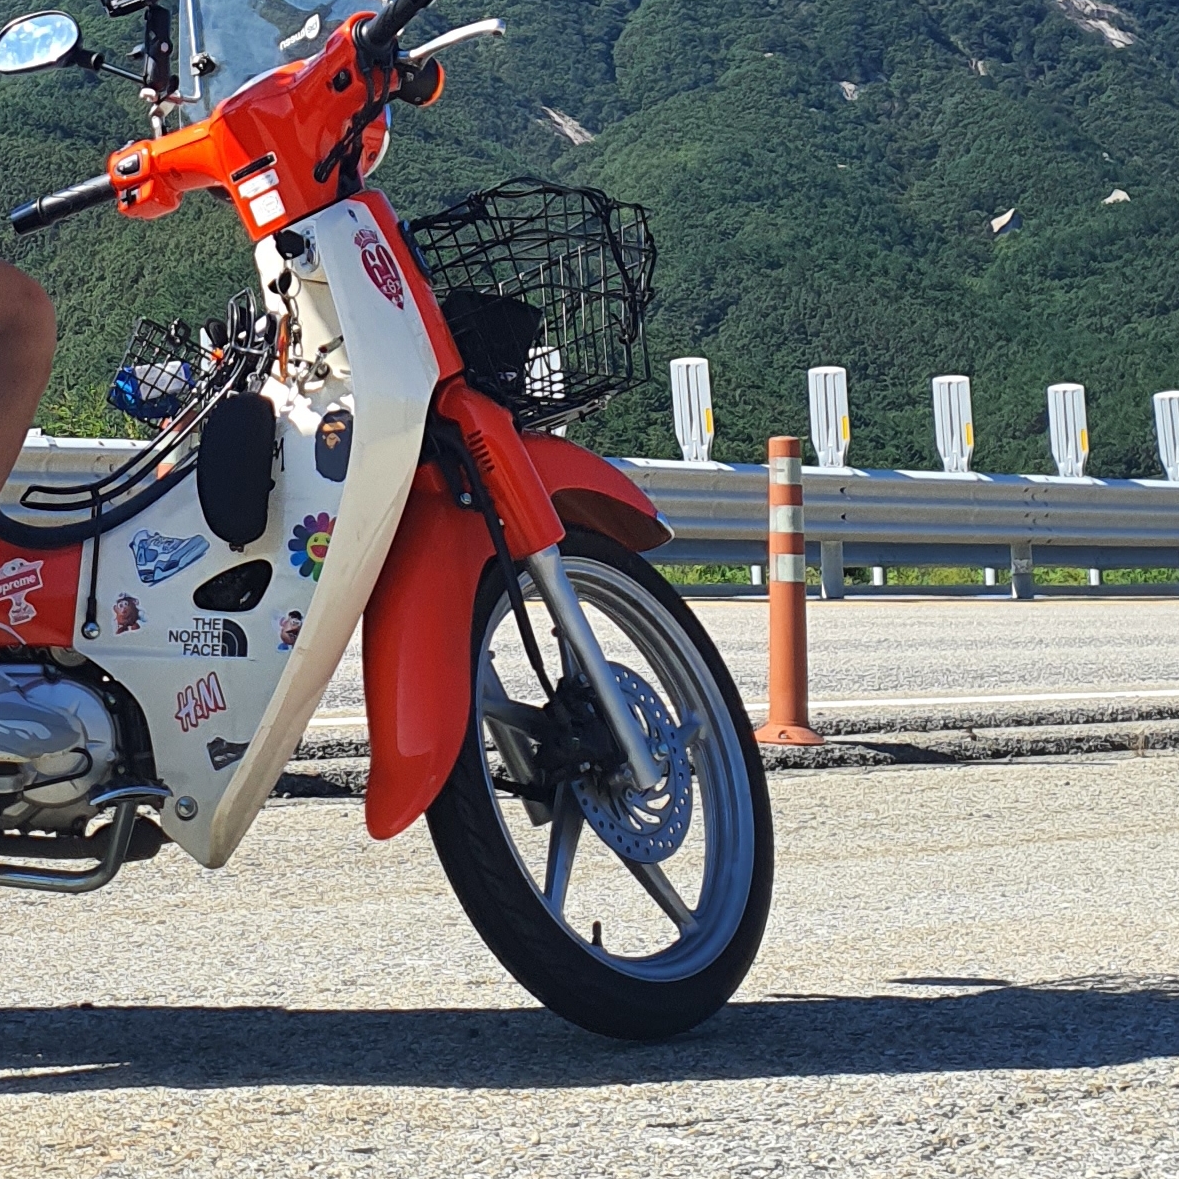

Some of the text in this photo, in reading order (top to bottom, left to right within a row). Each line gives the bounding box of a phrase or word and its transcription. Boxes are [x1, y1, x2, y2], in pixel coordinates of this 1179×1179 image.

[193, 617, 222, 630] THE
[168, 629, 221, 643] NORTH
[183, 643, 221, 656] FACE
[175, 671, 227, 733] H&M
